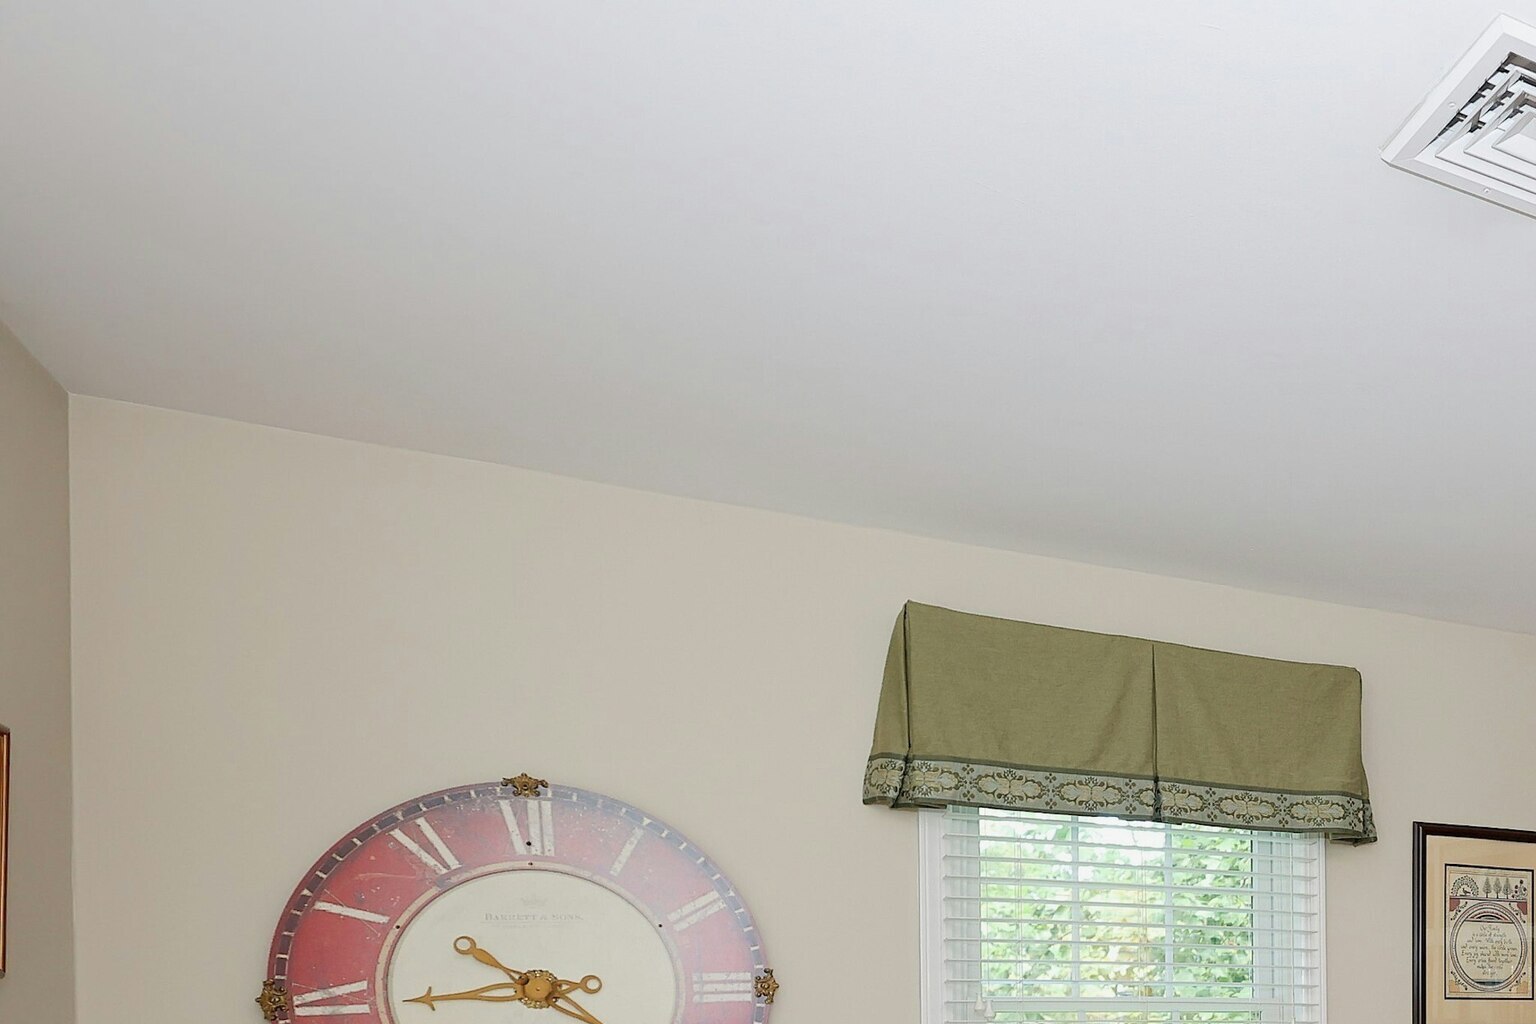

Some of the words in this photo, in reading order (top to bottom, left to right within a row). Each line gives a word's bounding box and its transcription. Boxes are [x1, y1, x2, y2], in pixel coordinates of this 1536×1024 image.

[610, 827, 645, 876] I
[667, 890, 728, 932] II
[692, 971, 753, 1003] III
